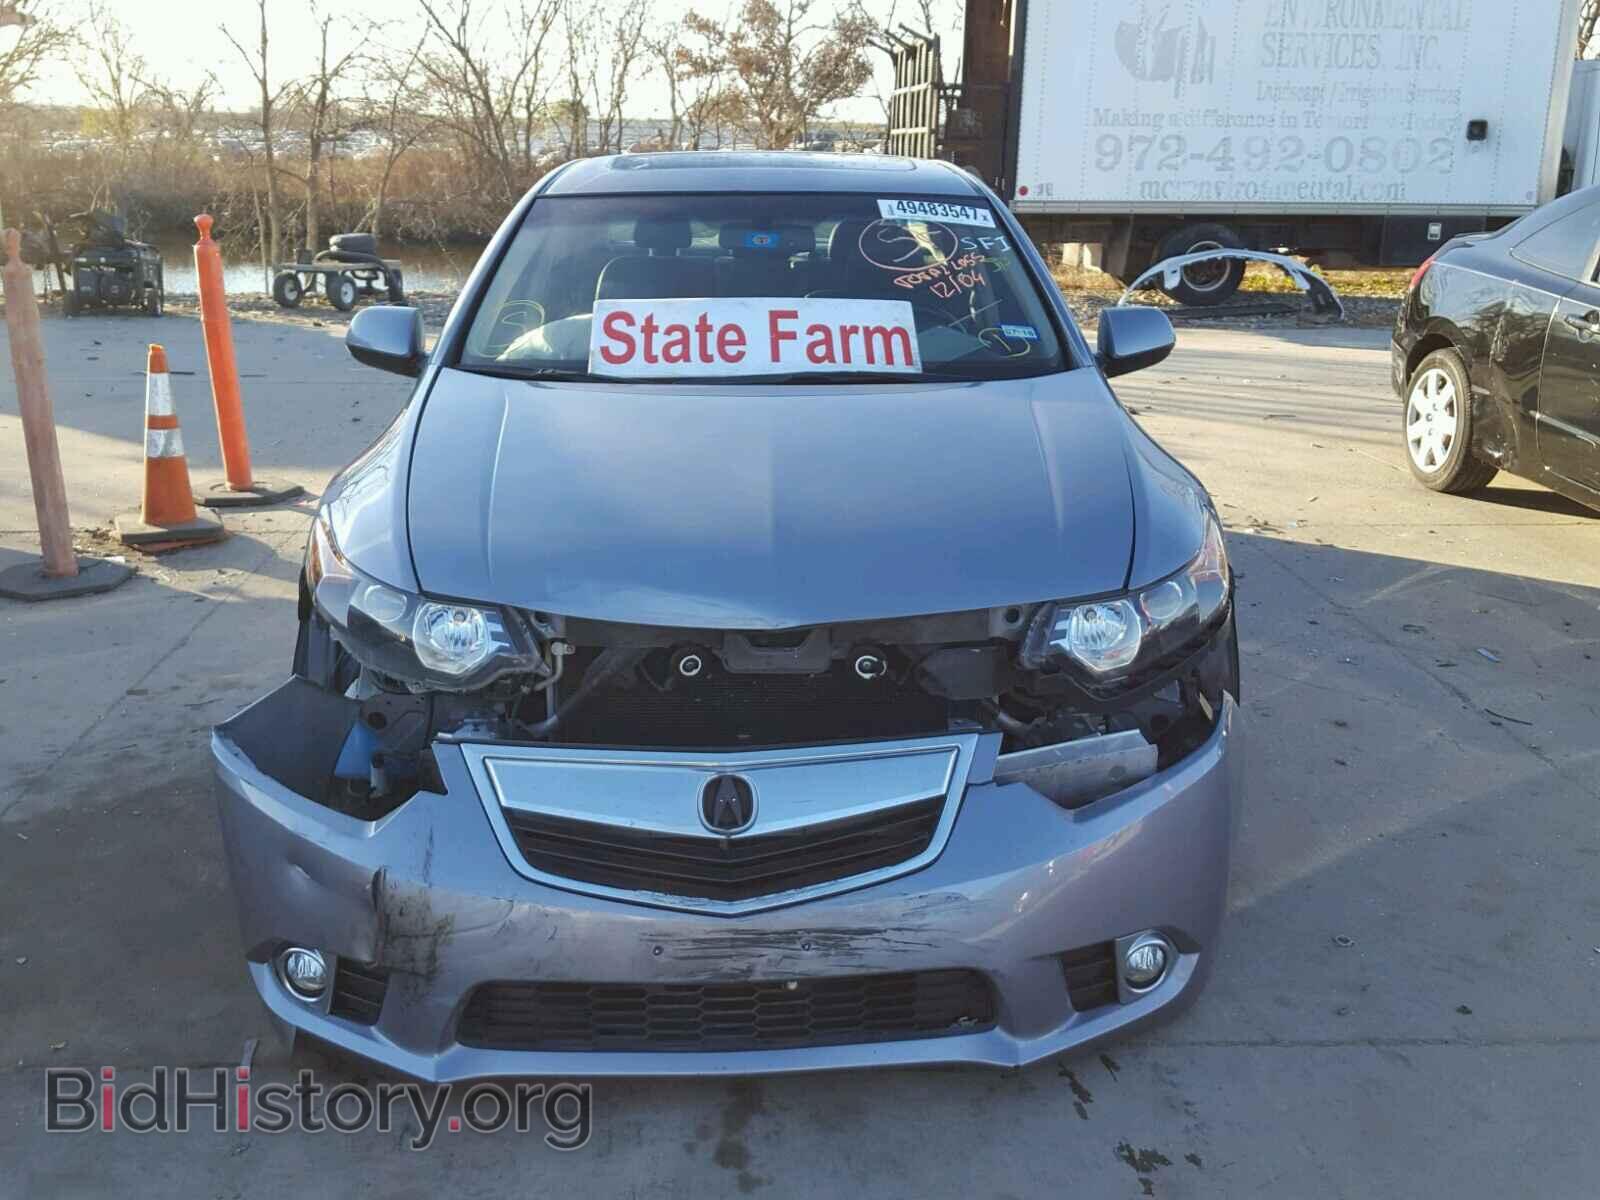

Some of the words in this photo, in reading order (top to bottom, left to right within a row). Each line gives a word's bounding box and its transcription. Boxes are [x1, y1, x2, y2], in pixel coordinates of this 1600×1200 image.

[1095, 133, 1456, 174] 972-492-0802
[896, 200, 978, 221] 49483547
[599, 310, 747, 366] State
[768, 309, 914, 367] Farm
